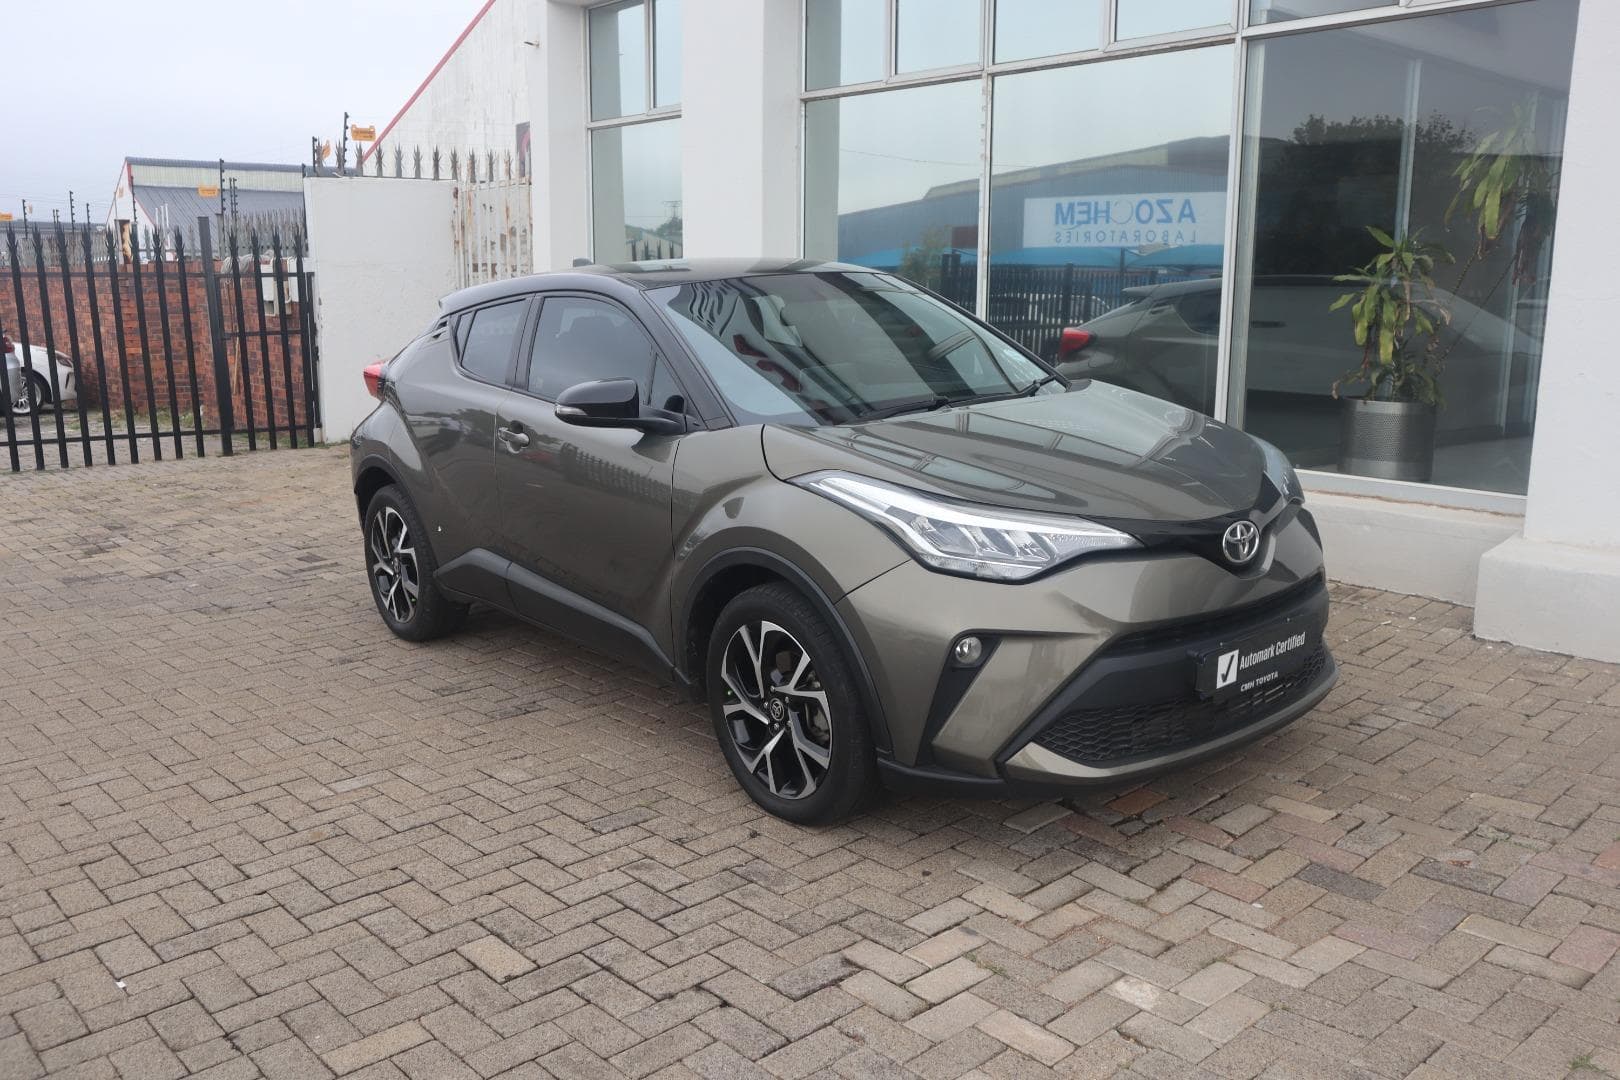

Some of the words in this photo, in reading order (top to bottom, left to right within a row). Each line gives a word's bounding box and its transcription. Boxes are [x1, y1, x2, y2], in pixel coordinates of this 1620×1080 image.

[1239, 644, 1275, 670] Automark
[1275, 632, 1306, 656] Certified
[1240, 681, 1255, 692] CMH
[1255, 671, 1279, 686] TOYOTA
